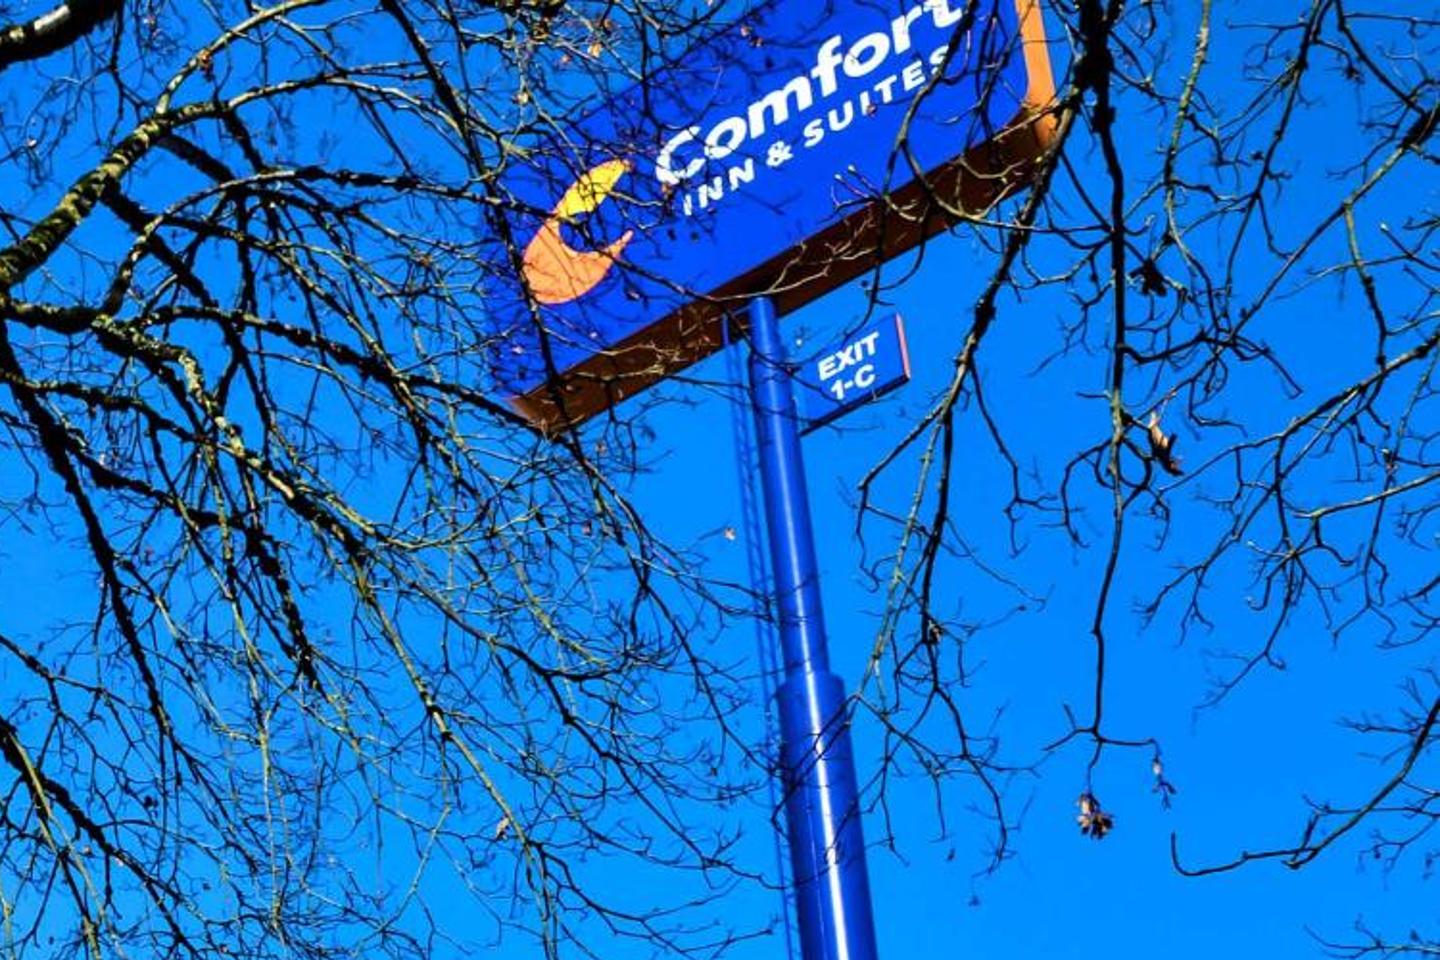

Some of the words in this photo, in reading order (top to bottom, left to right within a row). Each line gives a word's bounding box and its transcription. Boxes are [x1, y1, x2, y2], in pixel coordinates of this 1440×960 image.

[656, 0, 962, 185] Comfort
[683, 157, 755, 216] INN
[766, 140, 794, 167] &
[818, 331, 879, 381] EXIT
[831, 364, 876, 400] 1-C
